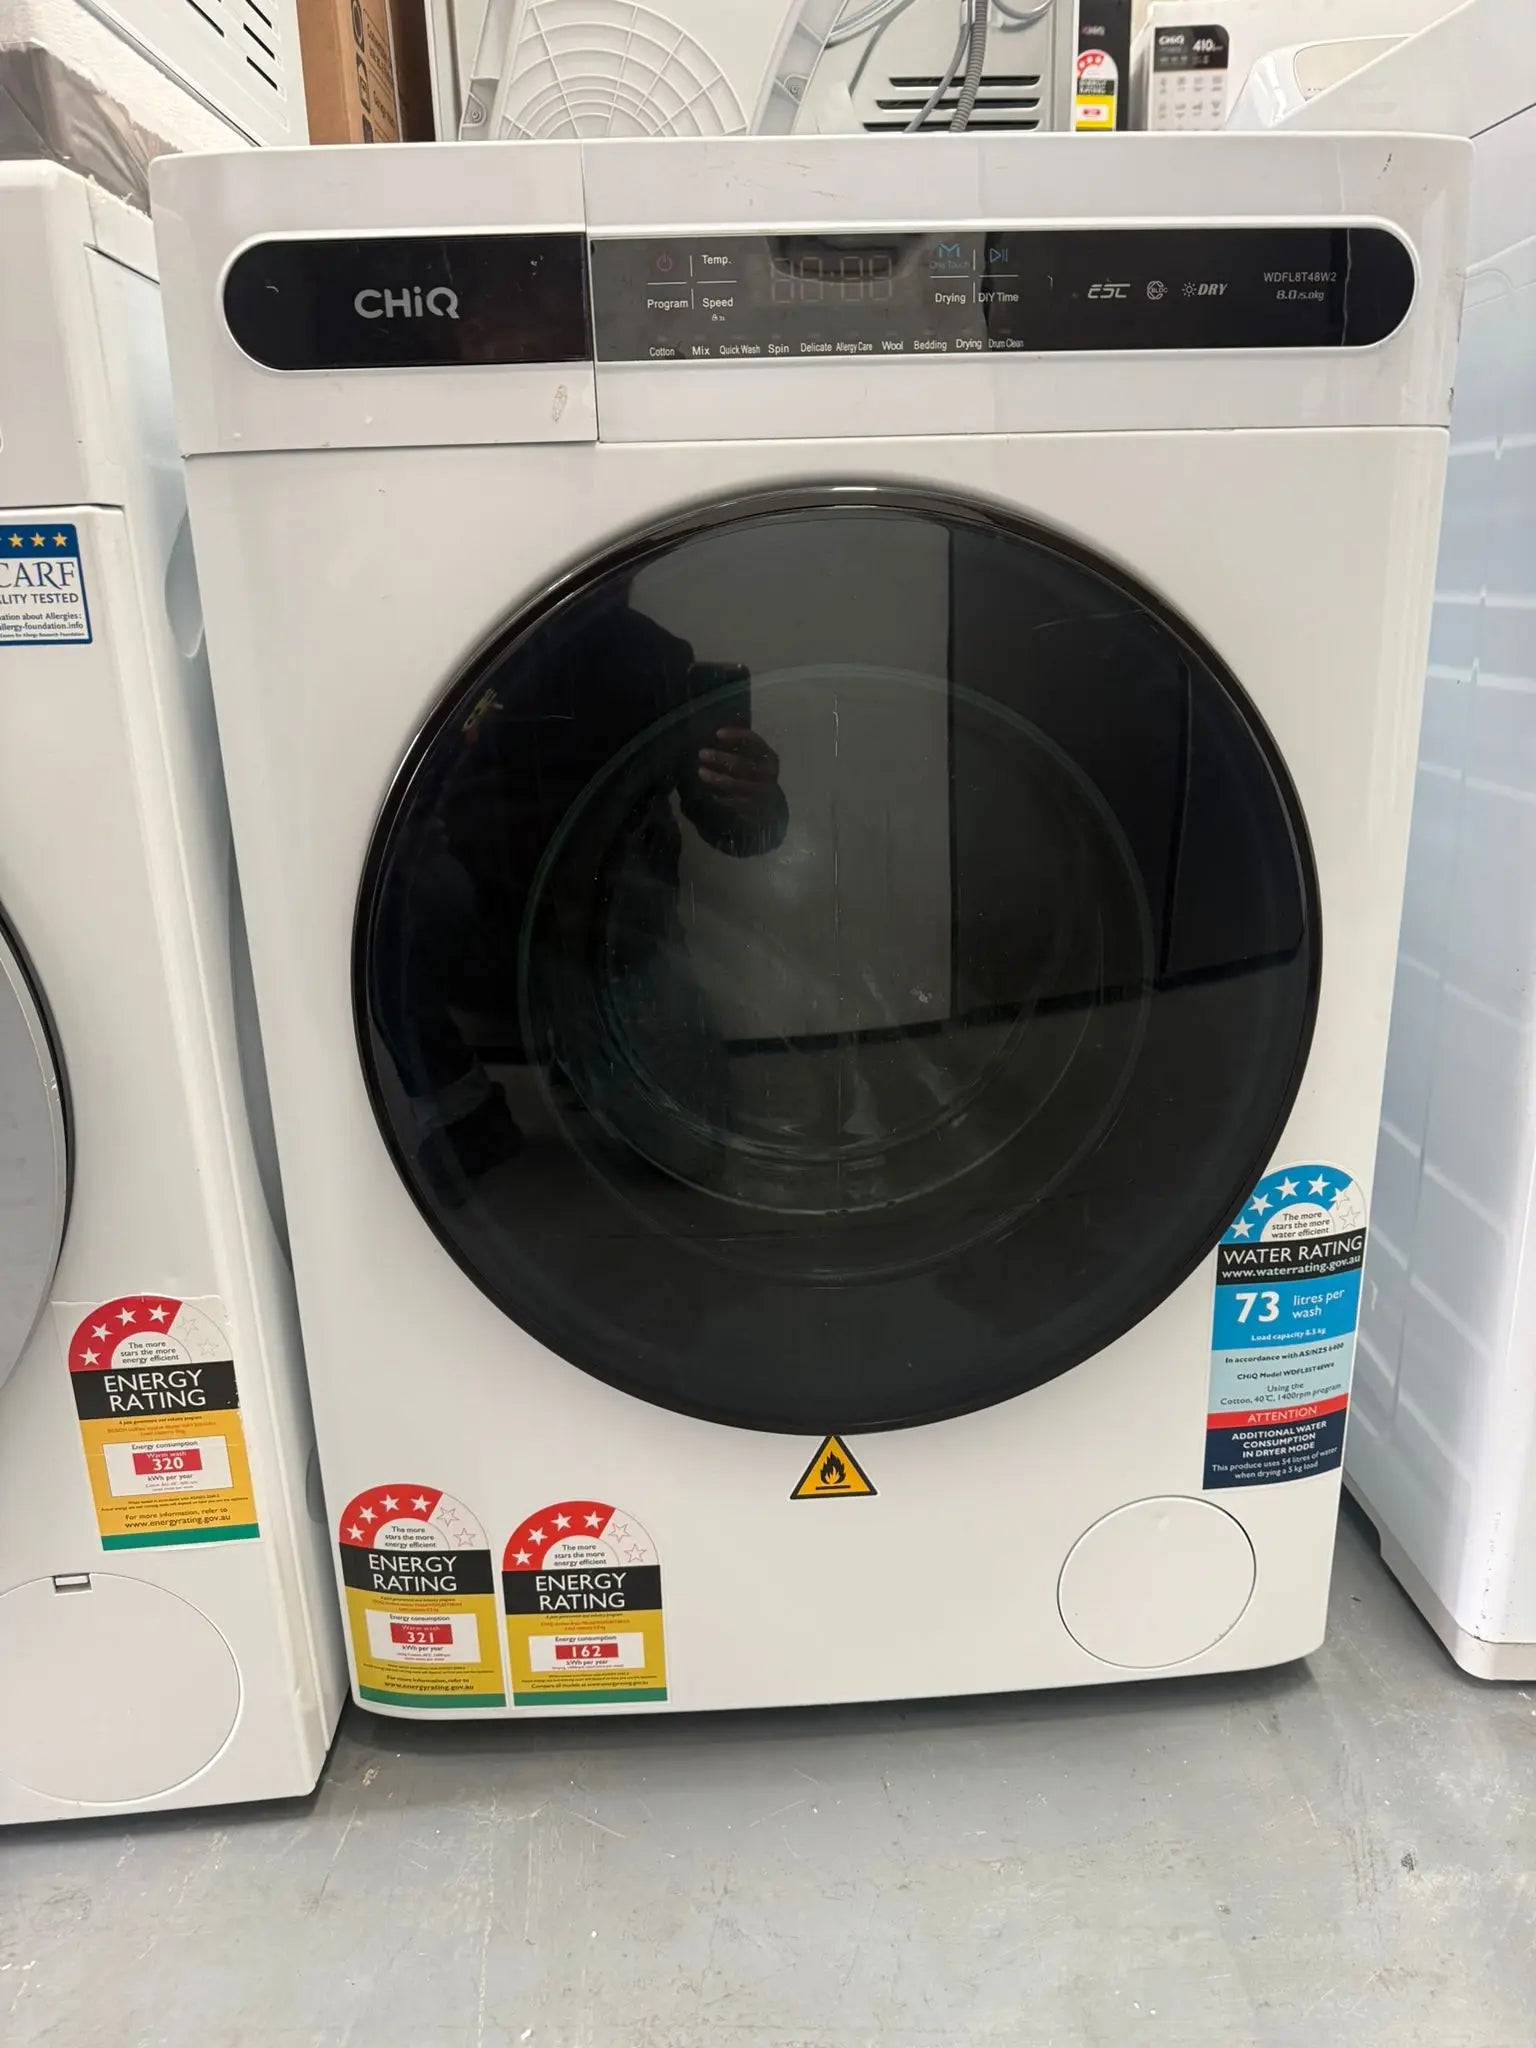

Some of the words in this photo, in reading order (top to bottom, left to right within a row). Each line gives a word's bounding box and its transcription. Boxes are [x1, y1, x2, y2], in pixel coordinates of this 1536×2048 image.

[702, 255, 732, 265] Temp.
[1264, 272, 1337, 282] WDFL8T48W2
[1198, 283, 1229, 295] DRY
[354, 286, 460, 319] CHiQ
[935, 293, 966, 304] Drying
[978, 293, 995, 302] DIY
[997, 293, 1019, 301] Time
[647, 299, 688, 311] Program
[703, 298, 733, 309] Speed
[768, 344, 789, 354] Spin
[800, 343, 832, 353] Delicate
[836, 342, 857, 353] Allergy
[858, 342, 872, 351] Care
[882, 341, 903, 350] Wool
[914, 340, 947, 352] Bedding
[956, 339, 982, 350] Drying
[988, 339, 1005, 348] Drum
[1006, 339, 1024, 347] Clean
[650, 347, 675, 356] Cotton
[692, 346, 710, 355] Mix
[720, 345, 739, 355] Quick
[740, 345, 760, 354] Wash
[30, 593, 79, 604] TESTED
[45, 612, 81, 621] Allergies:
[1283, 1213, 1299, 1221] The
[1298, 1227, 1329, 1237] efficient
[1223, 1247, 1292, 1265] WATER
[1298, 1236, 1362, 1261] RATING
[1222, 1255, 1361, 1278] www.waterrating.gov.au
[1293, 1294, 1323, 1306] litres
[1326, 1289, 1344, 1303] per
[1235, 1291, 1280, 1323] 73
[1292, 1305, 1322, 1319] wash
[1273, 1331, 1303, 1340] capacity
[121, 1349, 139, 1357] stars
[150, 1354, 179, 1362] efficient
[1235, 1355, 1280, 1363] accordance
[1260, 1371, 1282, 1379] Model
[103, 1369, 203, 1393] ENERGY
[1277, 1391, 1311, 1400] 1400rpm
[1312, 1383, 1341, 1396] program
[109, 1389, 206, 1412] RATING
[1247, 1406, 1317, 1423] ATTENTION
[1232, 1427, 1295, 1440] ADDITIONAL
[1296, 1421, 1327, 1433] WATER
[132, 1443, 154, 1451] Energy
[156, 1441, 198, 1449] consumption
[1243, 1433, 1316, 1448] CONSUMPTION
[1256, 1448, 1287, 1457] DRYER
[1288, 1442, 1315, 1453] MODE
[152, 1457, 184, 1471] 320
[1212, 1464, 1228, 1472] This
[1292, 1454, 1310, 1464] litres
[1311, 1451, 1319, 1459] of
[1320, 1446, 1338, 1456] water
[1257, 1469, 1281, 1479] drying
[1294, 1465, 1302, 1473] kg
[1304, 1461, 1319, 1470] load
[159, 1510, 200, 1518] information,
[124, 1514, 231, 1528] www.energyrating.gov.au
[368, 1554, 458, 1573] ENERGY
[373, 1574, 457, 1592] RATING
[536, 1572, 627, 1592] ENERGY
[540, 1592, 625, 1611] RATING
[390, 1614, 409, 1622] Energy
[407, 1632, 434, 1643] 321
[572, 1645, 602, 1658] 162
[384, 1681, 474, 1691] www.energyrating.gov.au
